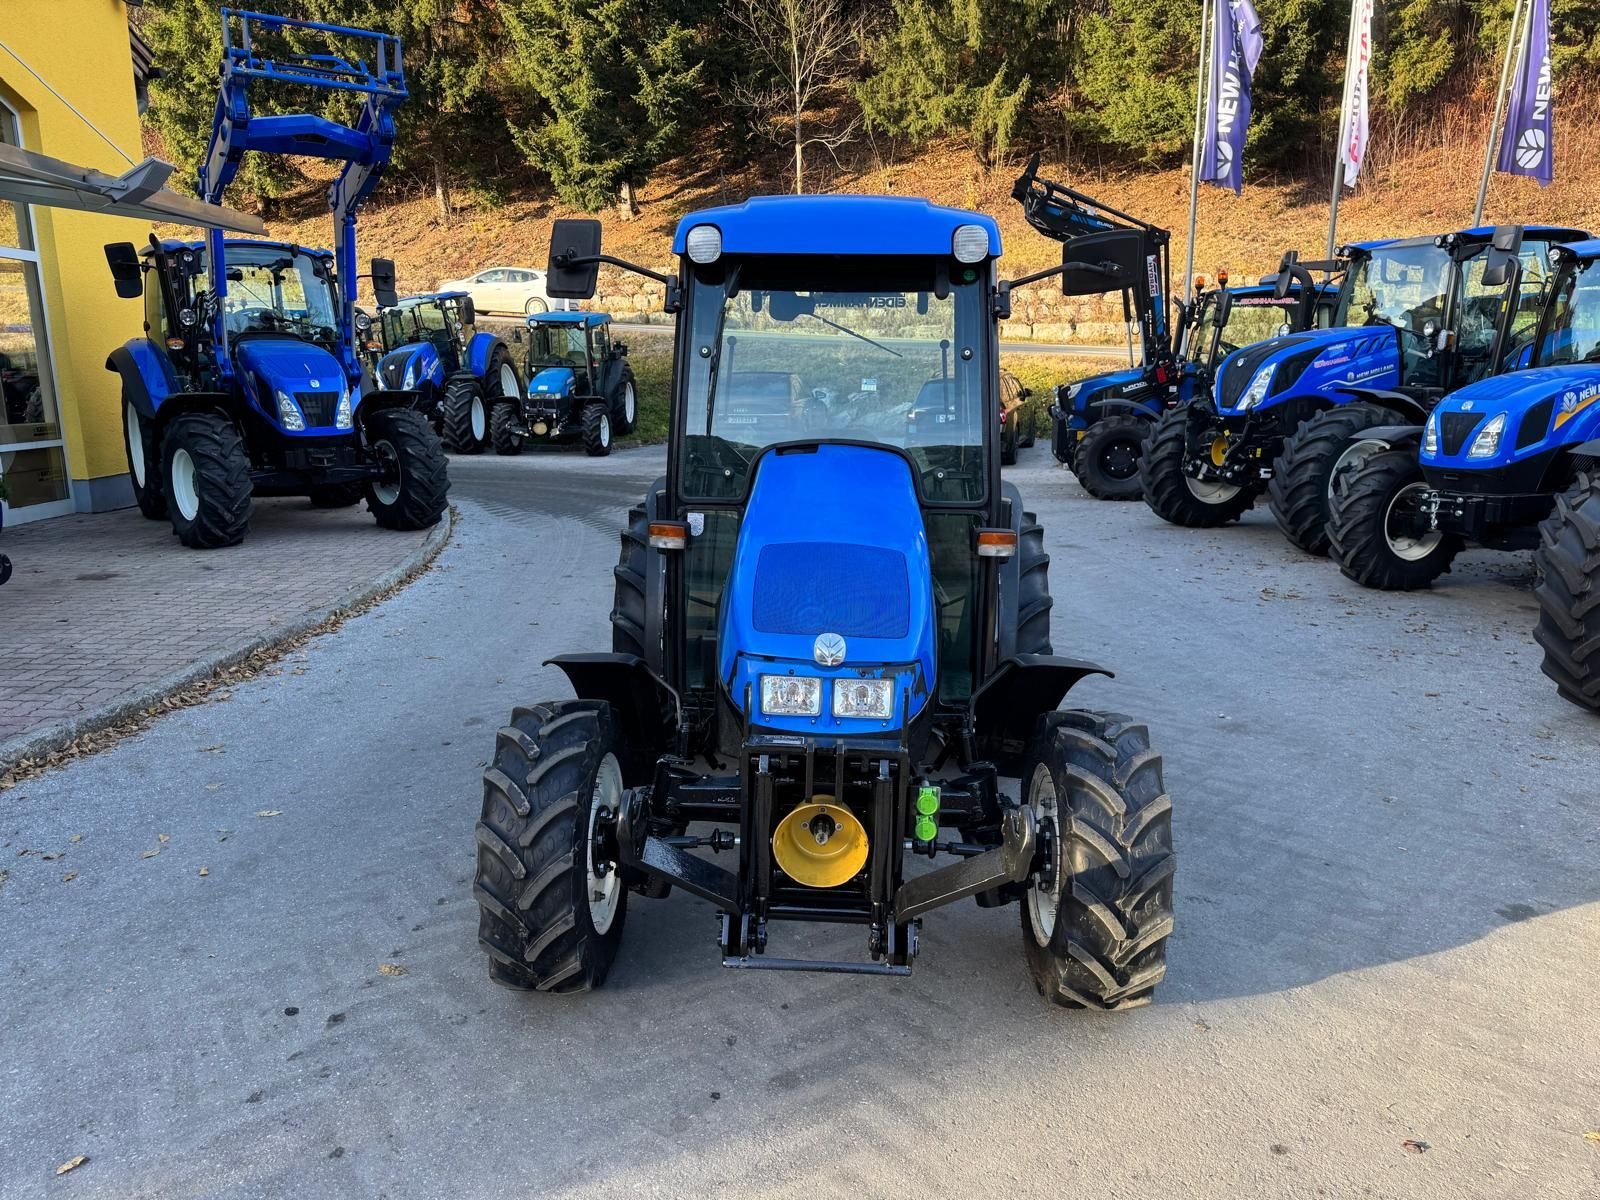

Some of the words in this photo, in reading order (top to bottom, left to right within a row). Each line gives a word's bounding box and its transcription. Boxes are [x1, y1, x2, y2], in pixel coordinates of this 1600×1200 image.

[1218, 71, 1241, 133] NEW
[1532, 56, 1551, 120] NEW
[1579, 383, 1597, 402] NEW
